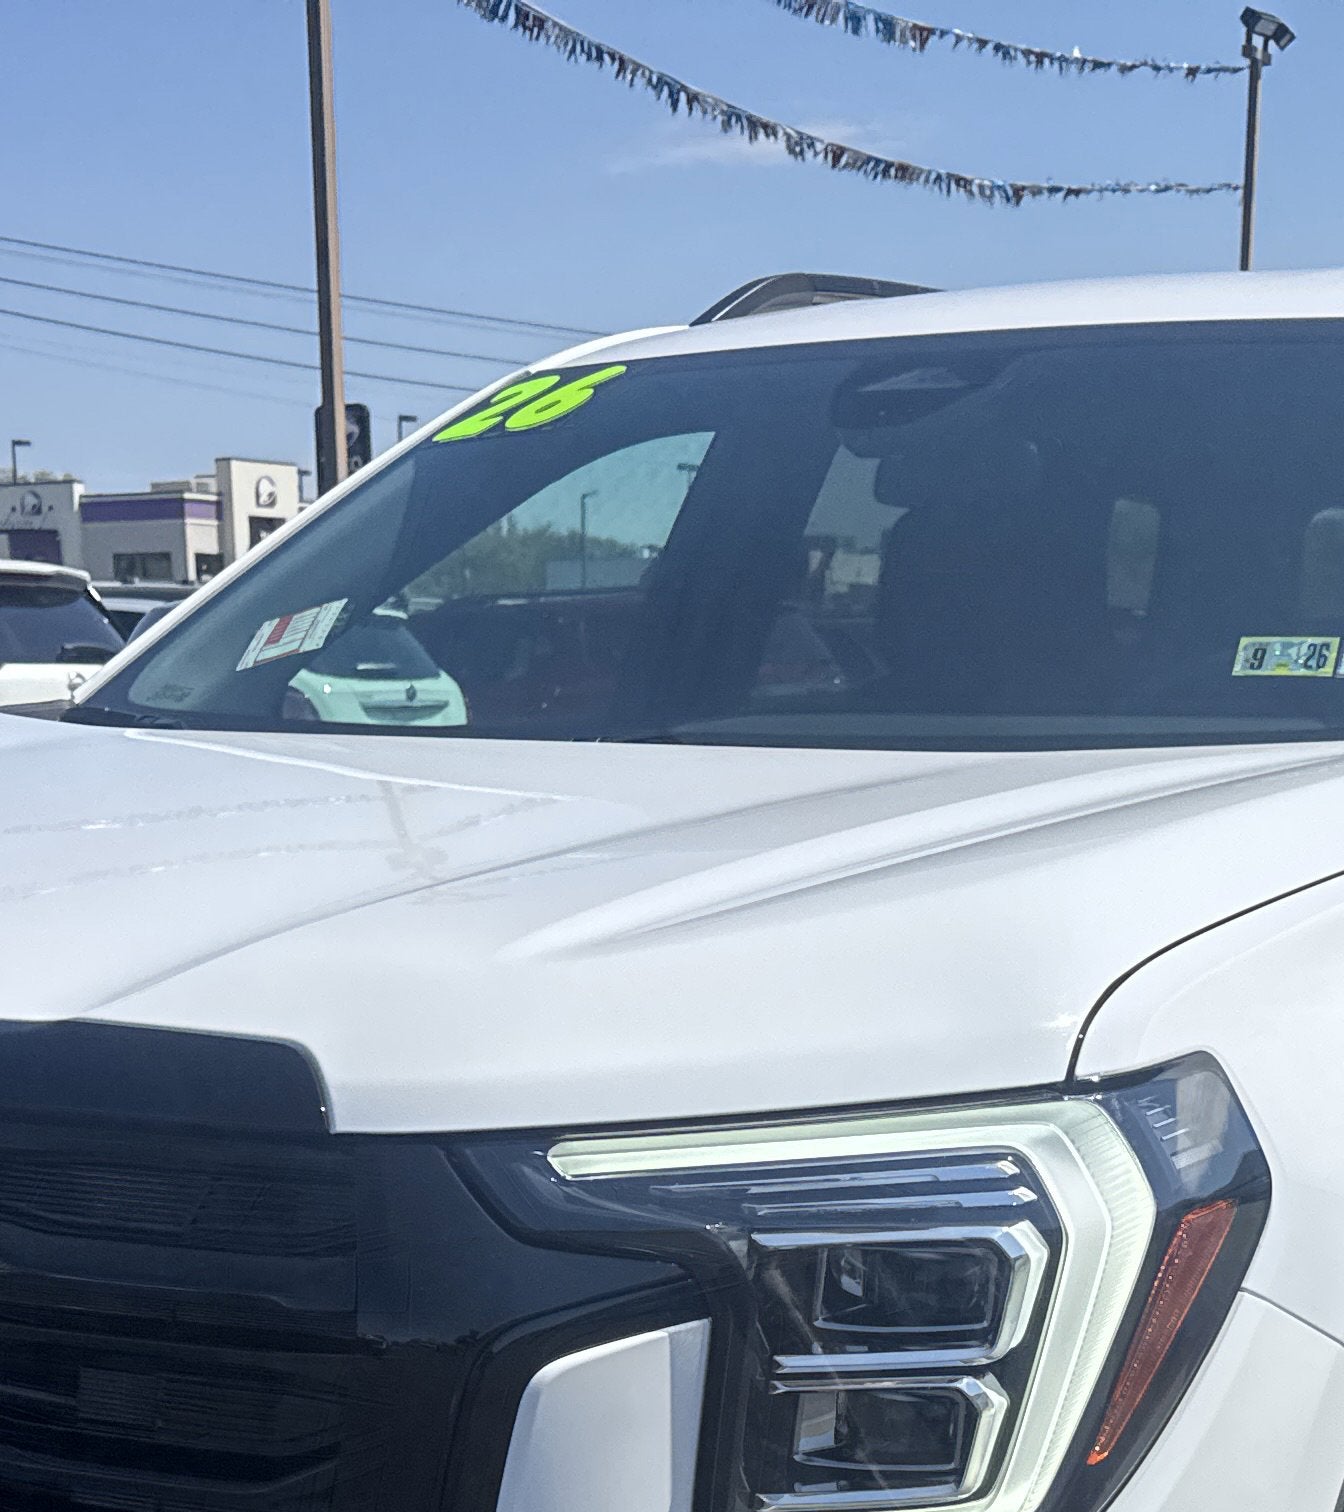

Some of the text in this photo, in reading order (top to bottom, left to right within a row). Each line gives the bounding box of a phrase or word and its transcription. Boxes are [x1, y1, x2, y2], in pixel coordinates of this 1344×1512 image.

[432, 365, 628, 443] 26
[1249, 643, 1330, 671] 9 26
